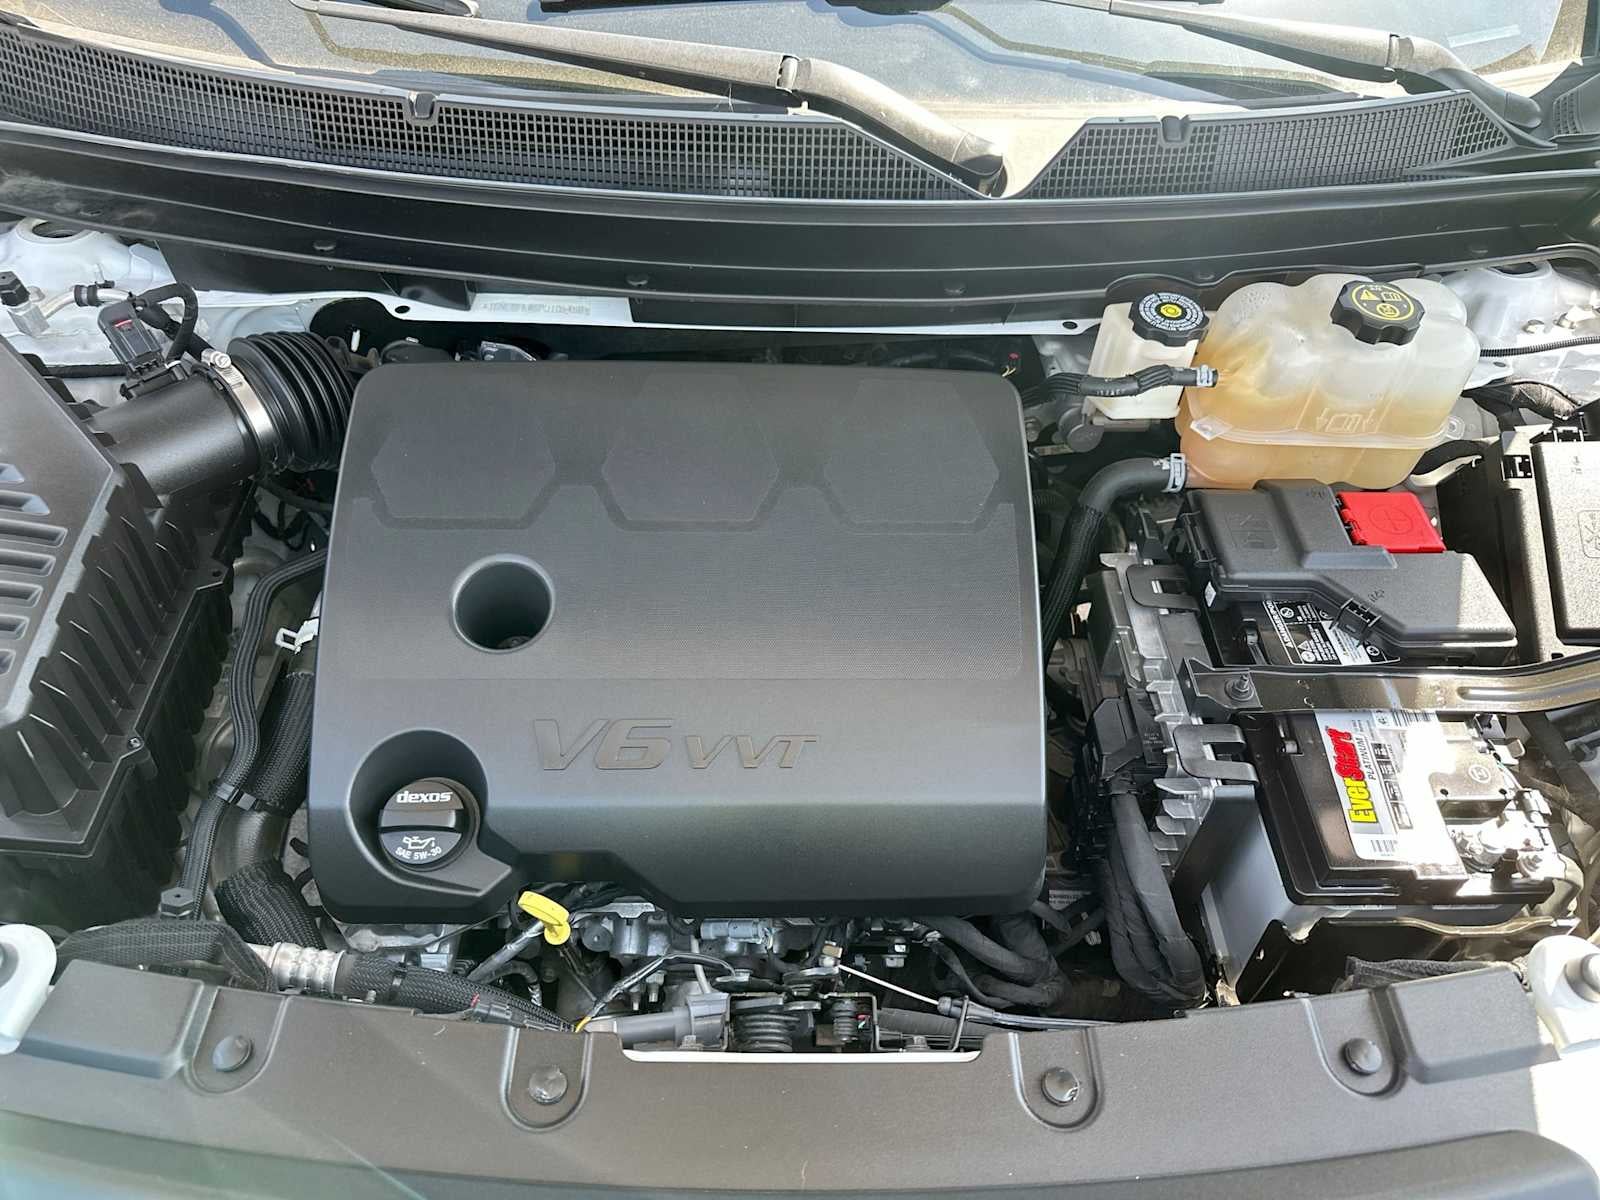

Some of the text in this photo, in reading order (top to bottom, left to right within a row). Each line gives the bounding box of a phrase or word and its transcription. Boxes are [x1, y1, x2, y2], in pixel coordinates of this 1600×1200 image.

[533, 718, 819, 770] V6 VVT
[1355, 738, 1377, 780] PLATINUM
[1327, 727, 1379, 823] EverStart
[396, 790, 453, 804] dexos
[395, 846, 442, 860] SAE 5W-30
